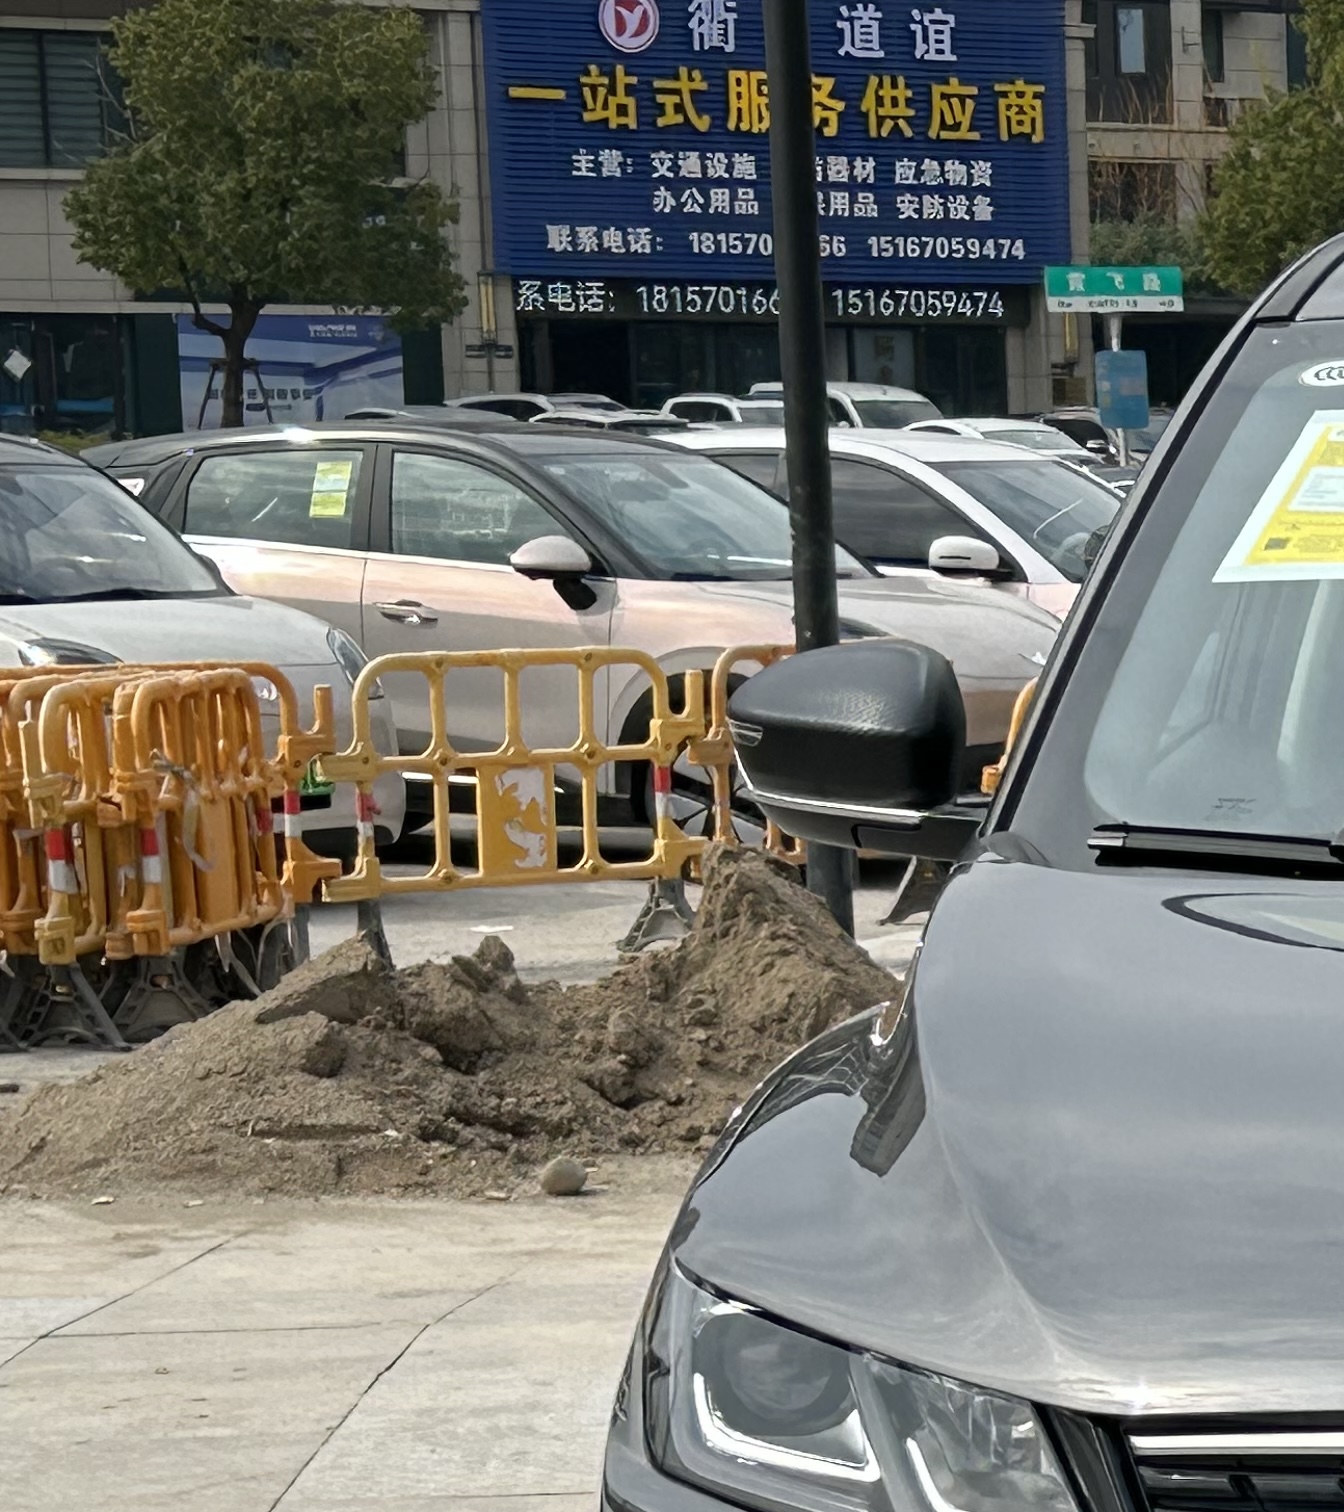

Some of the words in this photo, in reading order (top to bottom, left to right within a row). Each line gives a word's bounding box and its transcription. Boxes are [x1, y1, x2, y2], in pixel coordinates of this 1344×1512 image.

[507, 63, 1046, 143] 一站式服务供应商
[650, 151, 758, 180] 交通设施
[894, 158, 993, 188] 应急物资
[652, 186, 760, 216] 办公用品
[896, 193, 996, 222] 安防设备
[867, 236, 1027, 261] 15167059474
[831, 288, 1005, 319] 15167059474
